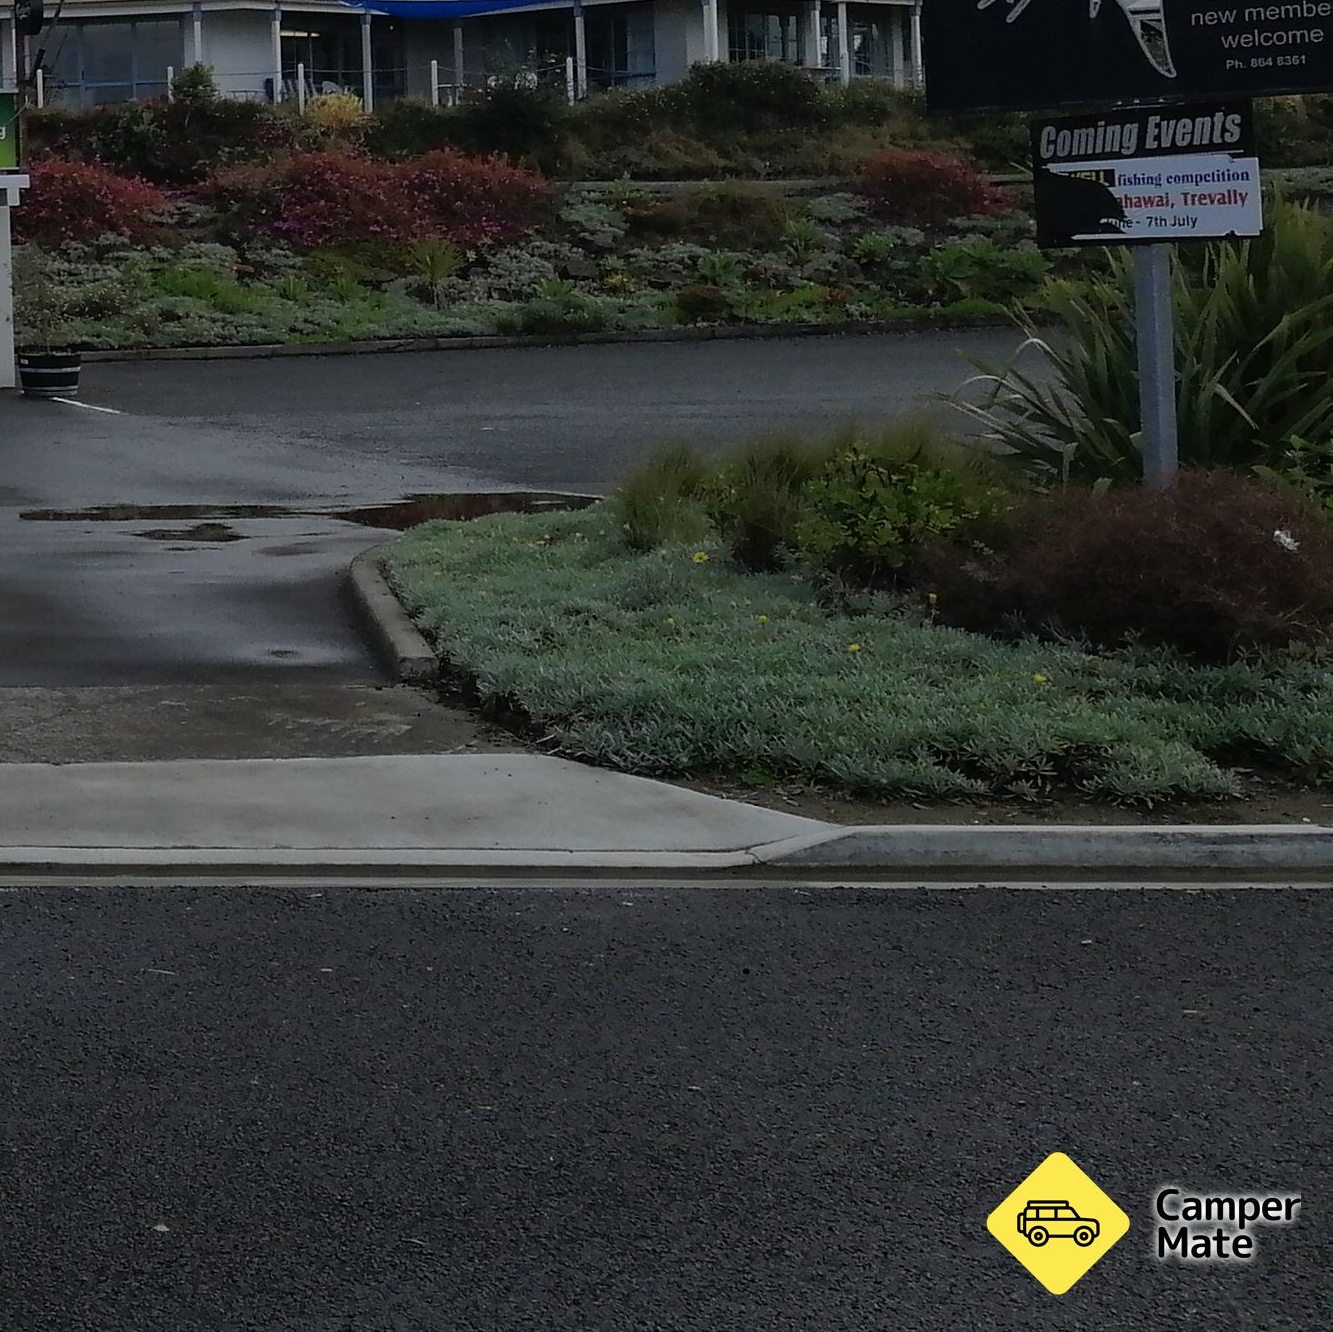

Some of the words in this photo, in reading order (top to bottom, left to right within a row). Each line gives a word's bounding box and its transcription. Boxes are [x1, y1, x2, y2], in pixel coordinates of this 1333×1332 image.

[1191, 9, 1237, 26] new
[1221, 28, 1325, 49] welcome
[1039, 120, 1139, 159] Coming
[1144, 111, 1242, 150] Events
[1117, 172, 1162, 188] fishing
[1166, 169, 1250, 187] competition
[1116, 192, 1175, 209] ahawai,
[1181, 189, 1248, 207] Trevally
[1147, 216, 1167, 228] 7th
[1172, 215, 1198, 229] July
